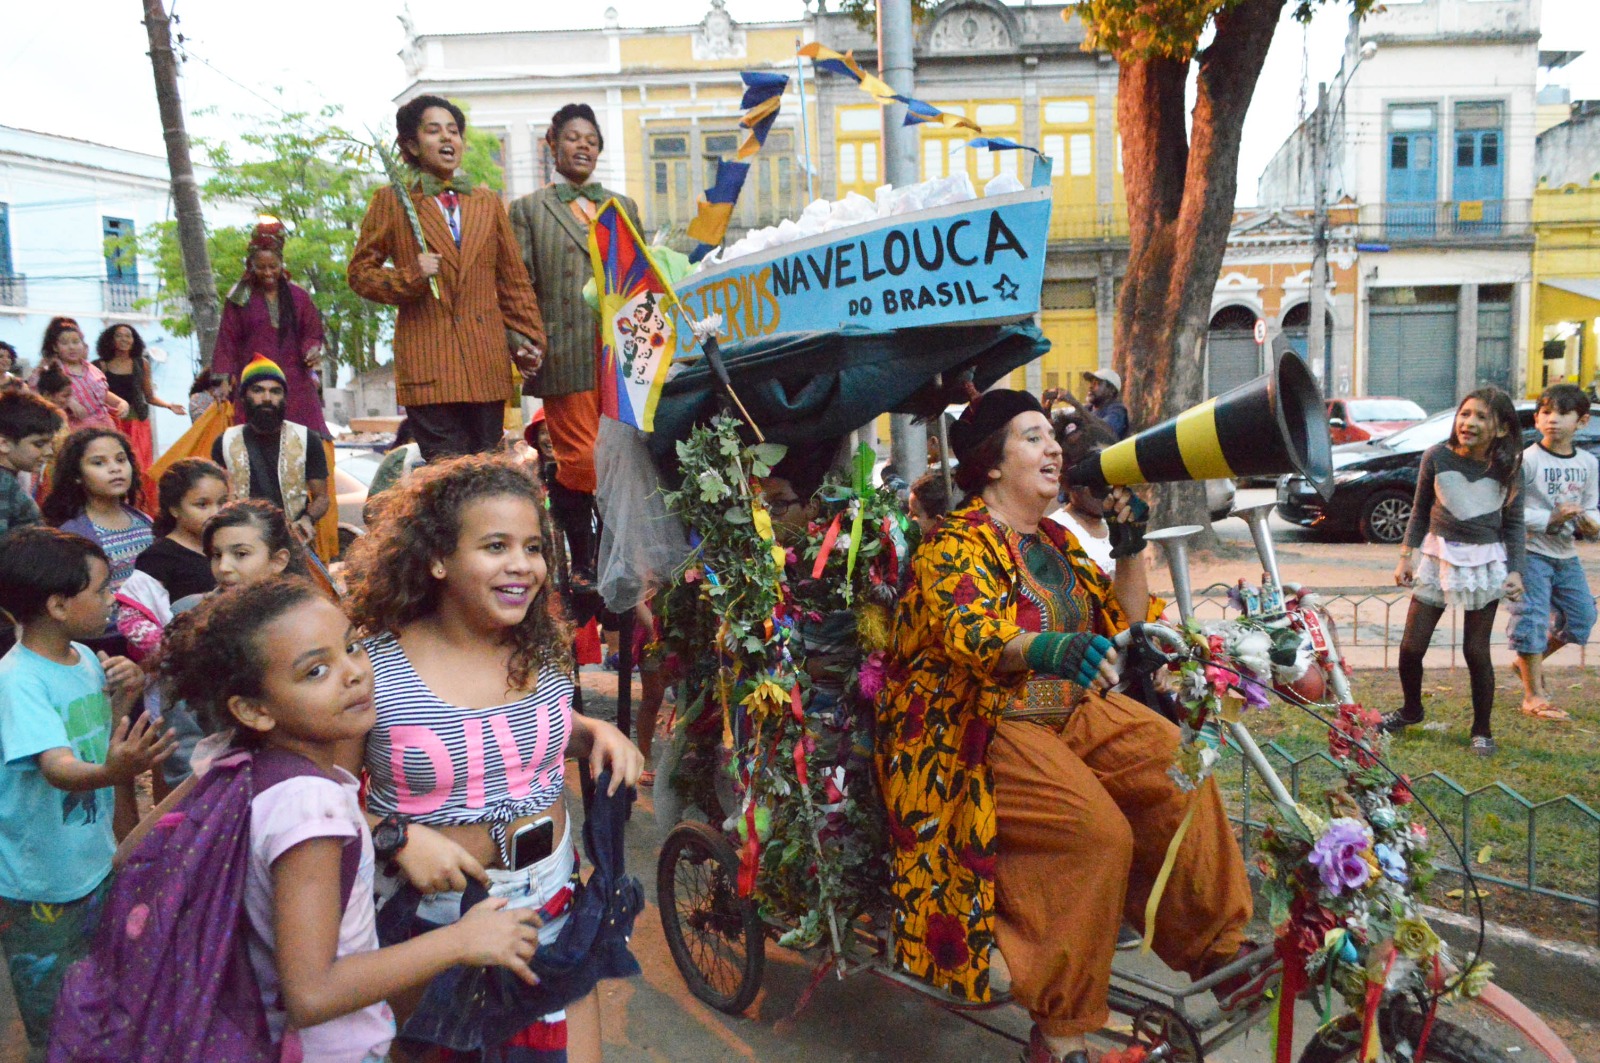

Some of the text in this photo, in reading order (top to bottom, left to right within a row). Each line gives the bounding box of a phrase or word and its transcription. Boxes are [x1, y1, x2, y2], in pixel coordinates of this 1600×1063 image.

[848, 277, 989, 317] DO BRASIL
[1544, 467, 1562, 482] TOP
